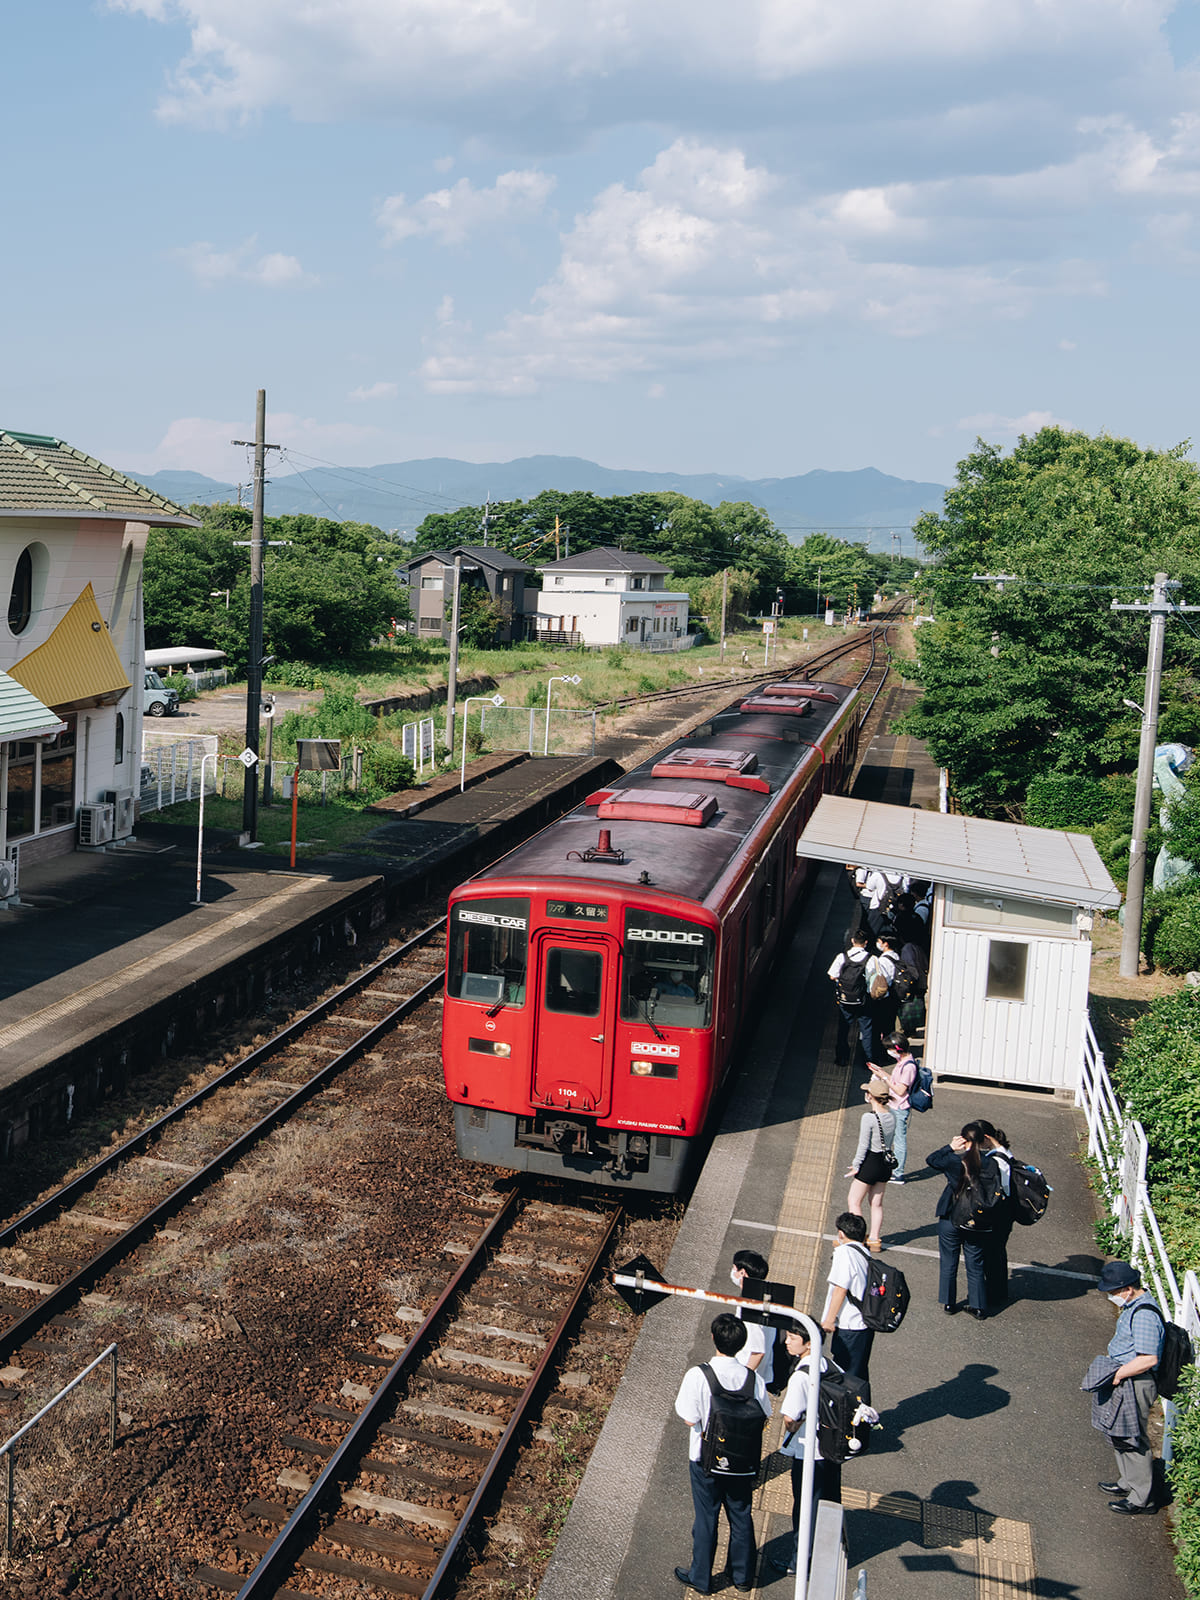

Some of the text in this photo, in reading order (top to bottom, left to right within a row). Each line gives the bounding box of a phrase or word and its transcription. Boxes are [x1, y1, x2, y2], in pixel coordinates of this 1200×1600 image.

[245, 751, 252, 763] 3
[575, 906, 607, 917] 久留米
[459, 912, 527, 928] DIESEL CAR
[627, 928, 704, 944] 200DC
[632, 1042, 679, 1056] 200DC
[558, 1088, 577, 1097] 1104
